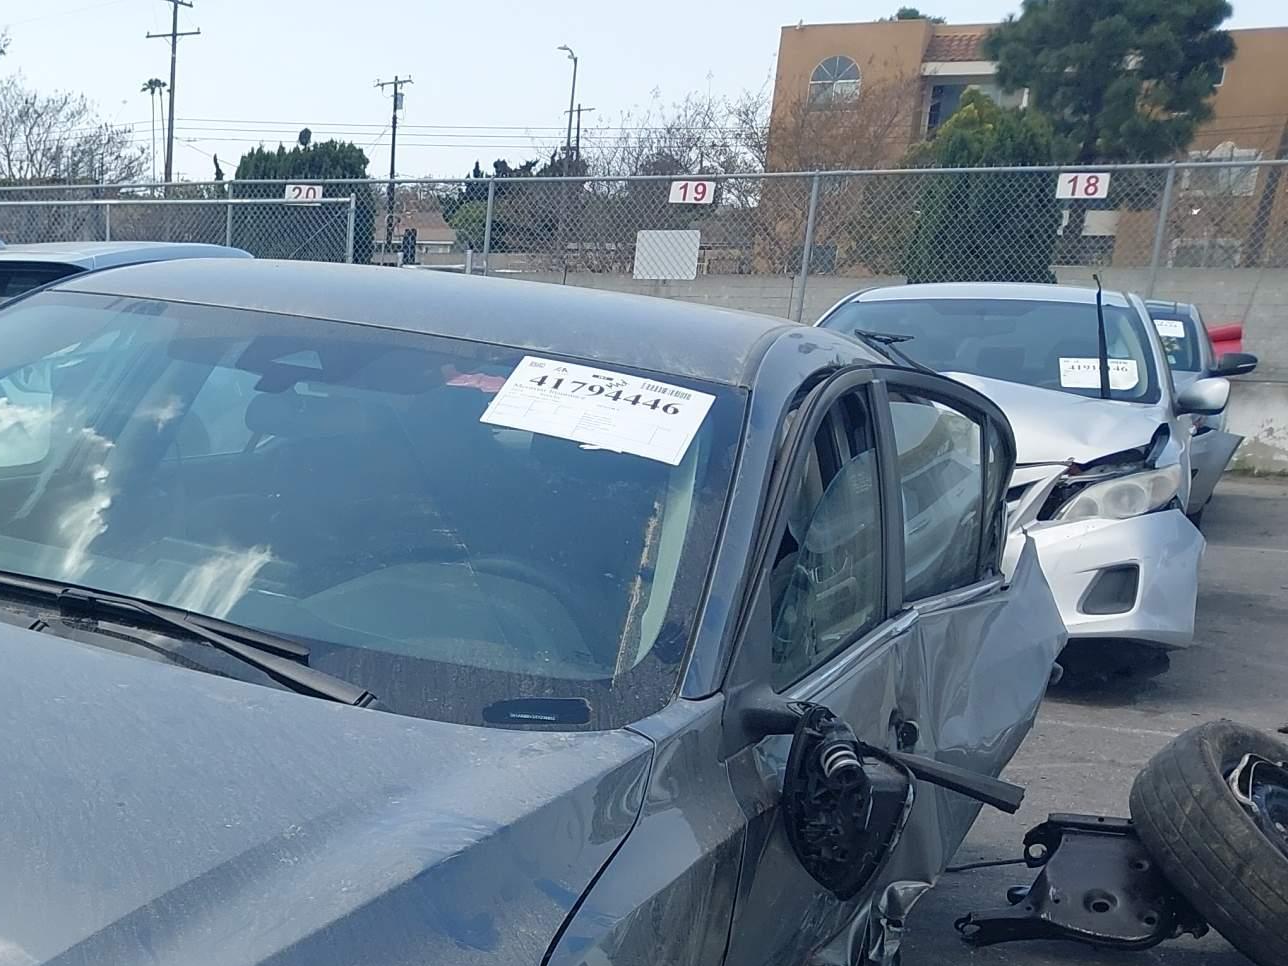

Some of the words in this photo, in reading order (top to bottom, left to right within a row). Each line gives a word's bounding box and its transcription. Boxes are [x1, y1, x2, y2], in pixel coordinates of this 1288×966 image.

[291, 186, 317, 203] 20
[679, 182, 707, 202] 19
[1067, 175, 1100, 197] 18
[528, 374, 684, 415] 41794446
